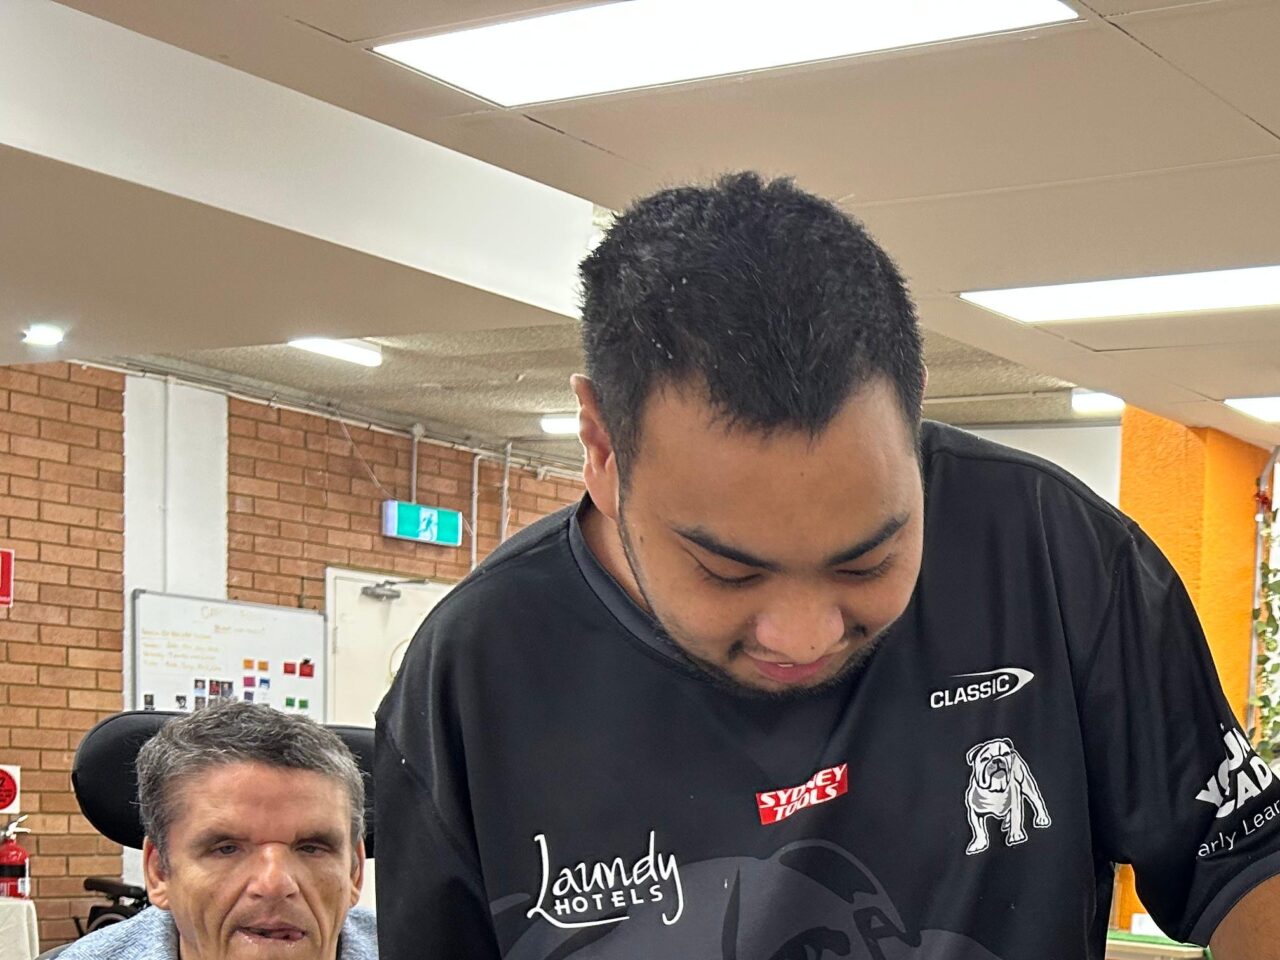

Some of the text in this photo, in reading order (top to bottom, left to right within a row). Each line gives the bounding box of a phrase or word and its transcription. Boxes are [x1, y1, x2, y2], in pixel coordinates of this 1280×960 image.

[930, 674, 1010, 709] CLASSIC
[773, 783, 838, 822] TOOLS
[526, 830, 684, 928] Laundy
[554, 884, 663, 916] HOTELS
